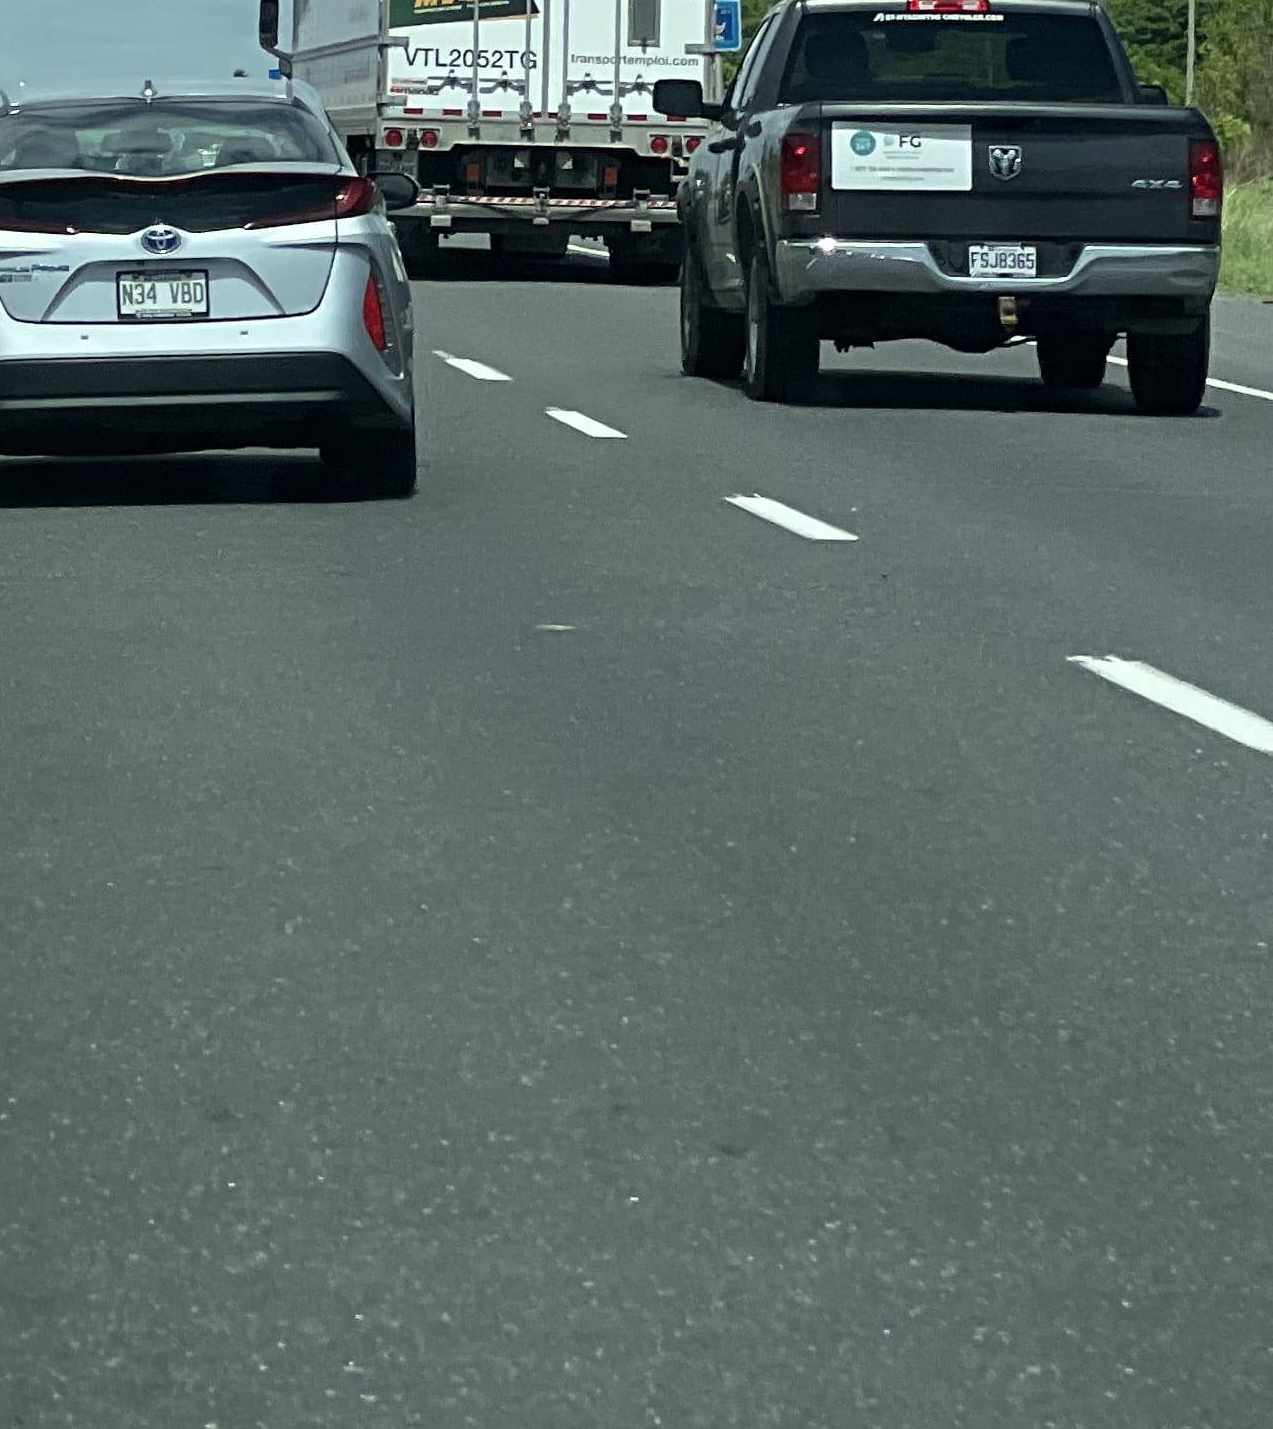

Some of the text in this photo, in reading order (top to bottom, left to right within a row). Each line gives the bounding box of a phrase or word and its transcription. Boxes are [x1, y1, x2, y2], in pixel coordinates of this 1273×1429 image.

[404, 48, 538, 70] VTL2052TG
[899, 135, 922, 148] FG
[970, 251, 1035, 270] FSJ8365
[121, 282, 157, 306] N34
